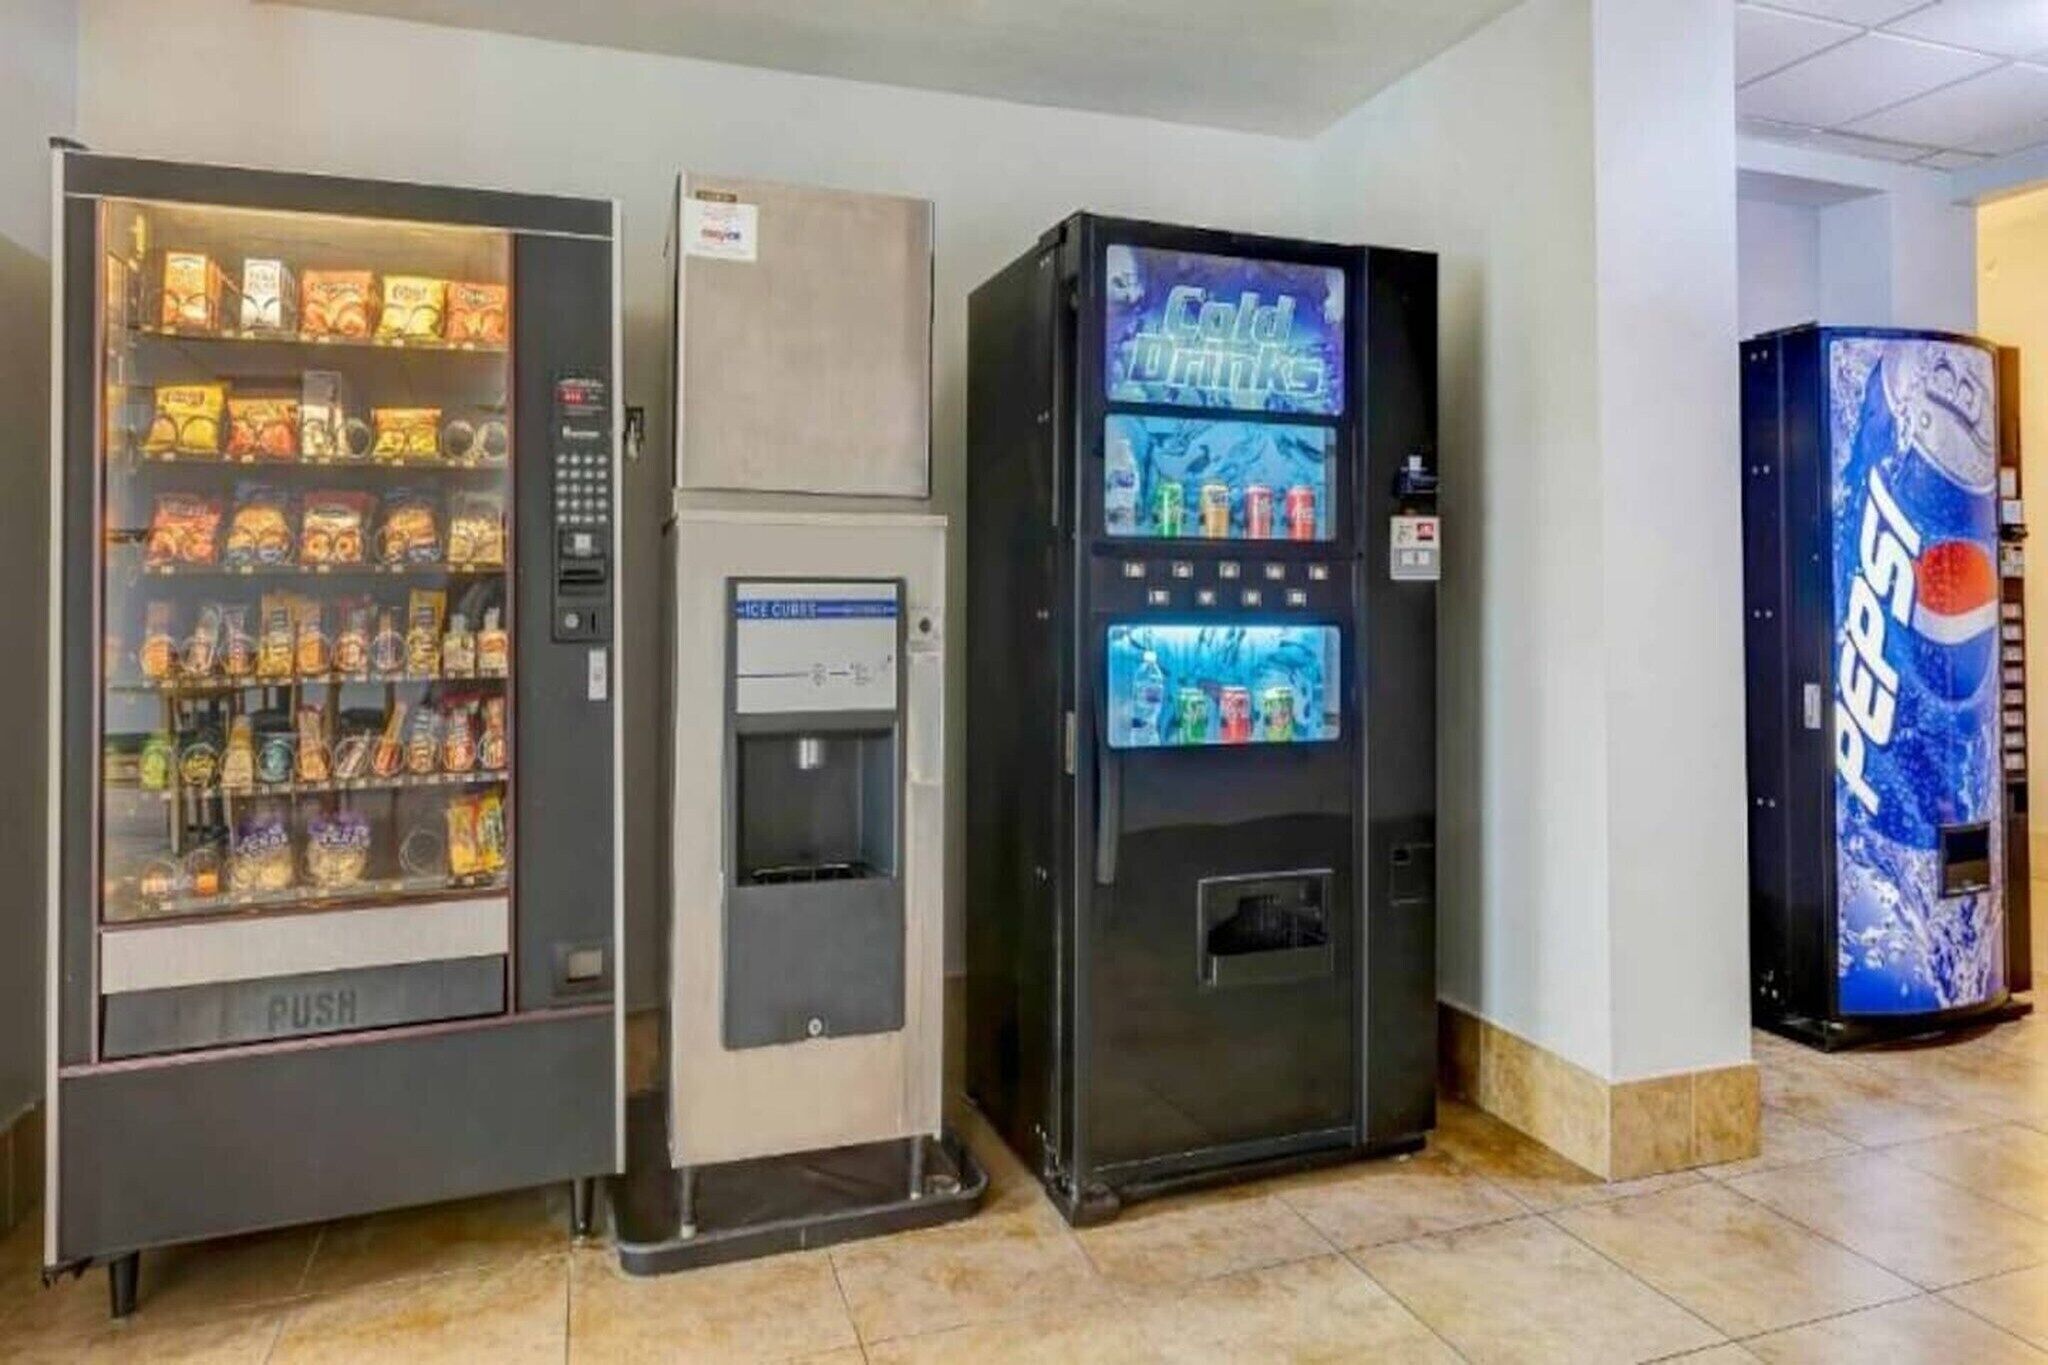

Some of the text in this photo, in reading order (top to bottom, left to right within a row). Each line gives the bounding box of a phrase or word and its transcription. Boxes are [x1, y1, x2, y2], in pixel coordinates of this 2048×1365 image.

[1165, 285, 1297, 346] Cold
[1128, 334, 1326, 398] Drinks
[745, 603, 769, 618] ICE
[1836, 465, 1921, 816] PEPSI
[269, 989, 358, 1031] PUSH
